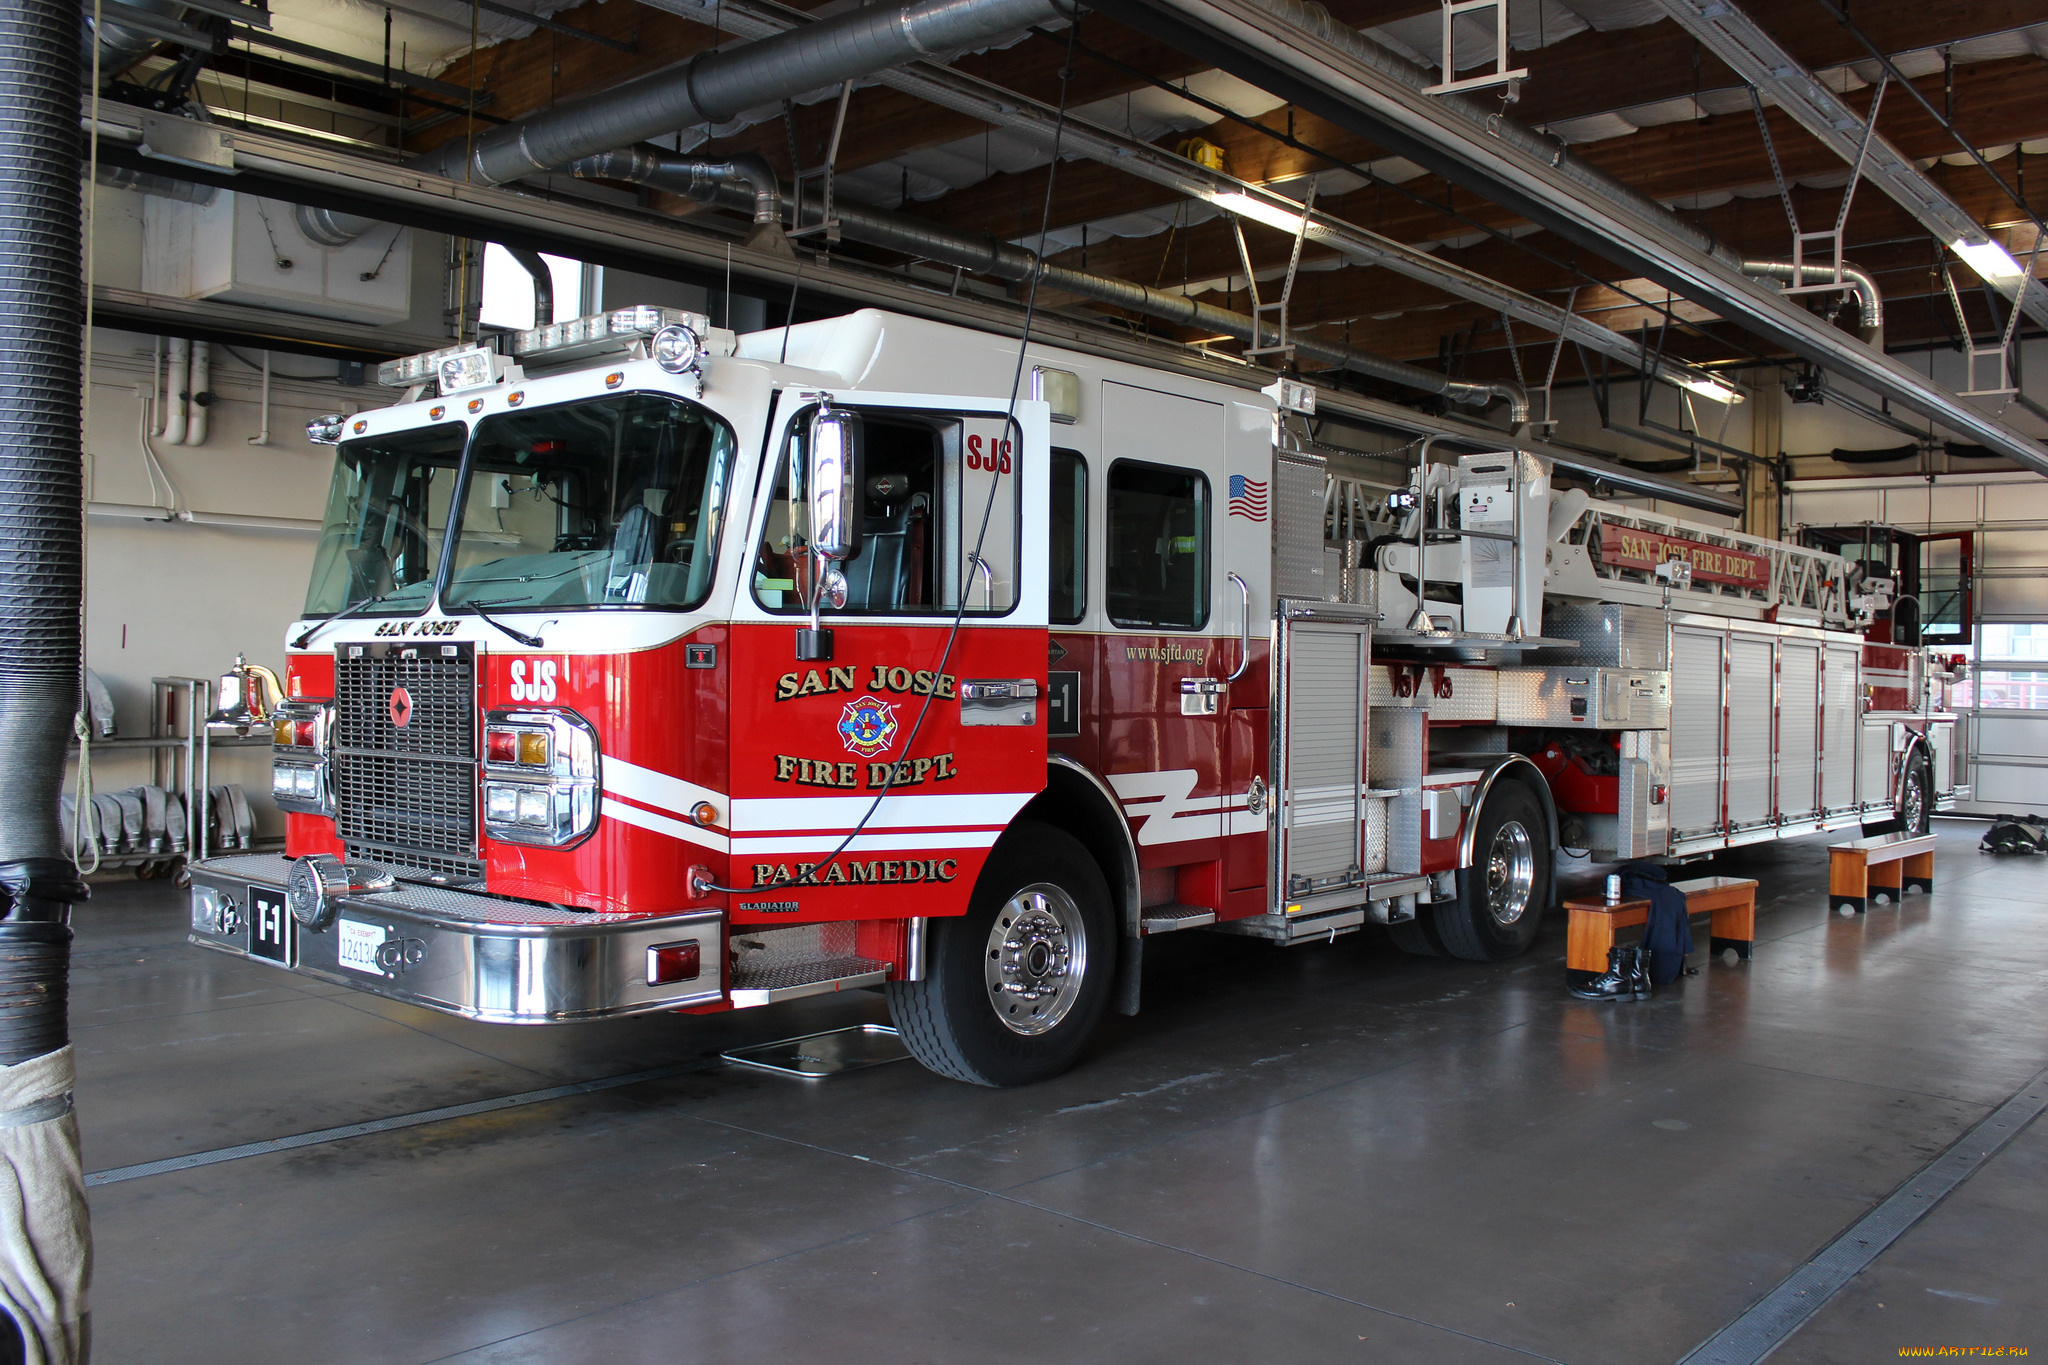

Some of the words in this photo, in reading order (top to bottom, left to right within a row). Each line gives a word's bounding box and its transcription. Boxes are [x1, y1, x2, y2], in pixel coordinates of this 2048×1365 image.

[967, 434, 1012, 475] SJS
[1621, 535, 1651, 561] SAN
[1692, 549, 1722, 574] FIRE
[1725, 555, 1757, 580] DEPT.
[374, 621, 415, 636] SAN
[413, 620, 462, 636] JOSE
[1126, 643, 1204, 666] www.sjfd.org
[510, 659, 557, 702] SJS
[775, 665, 857, 702] SAN
[867, 665, 956, 700] JOSE
[1047, 683, 1069, 722] -1
[774, 754, 858, 788] FIRE
[866, 752, 958, 790] DEPT.
[752, 858, 958, 889] PARAMEDIC
[257, 899, 280, 945] T-1
[739, 901, 799, 910] GLADIATOR
